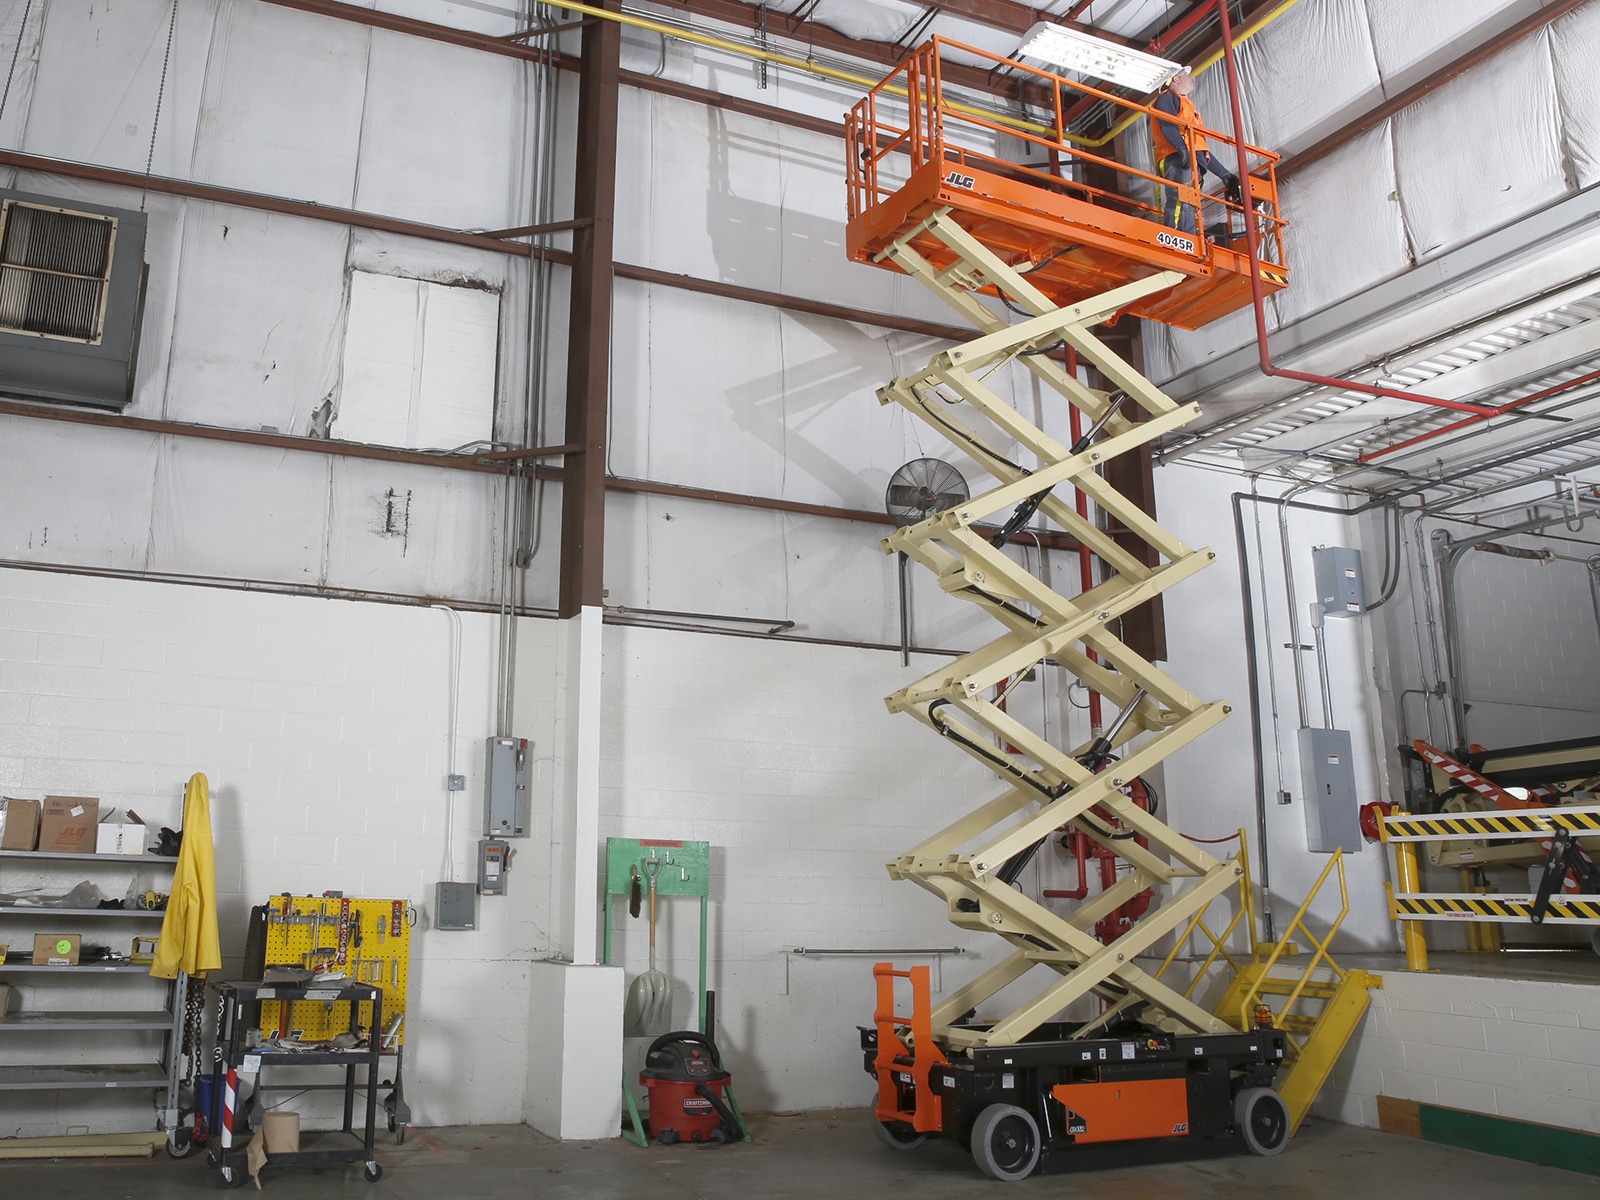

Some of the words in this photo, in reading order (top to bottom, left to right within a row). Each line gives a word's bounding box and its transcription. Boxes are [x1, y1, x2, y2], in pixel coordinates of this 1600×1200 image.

[946, 172, 975, 189] JLG
[1157, 232, 1194, 252] 4045R
[1173, 1122, 1188, 1133] JLG
